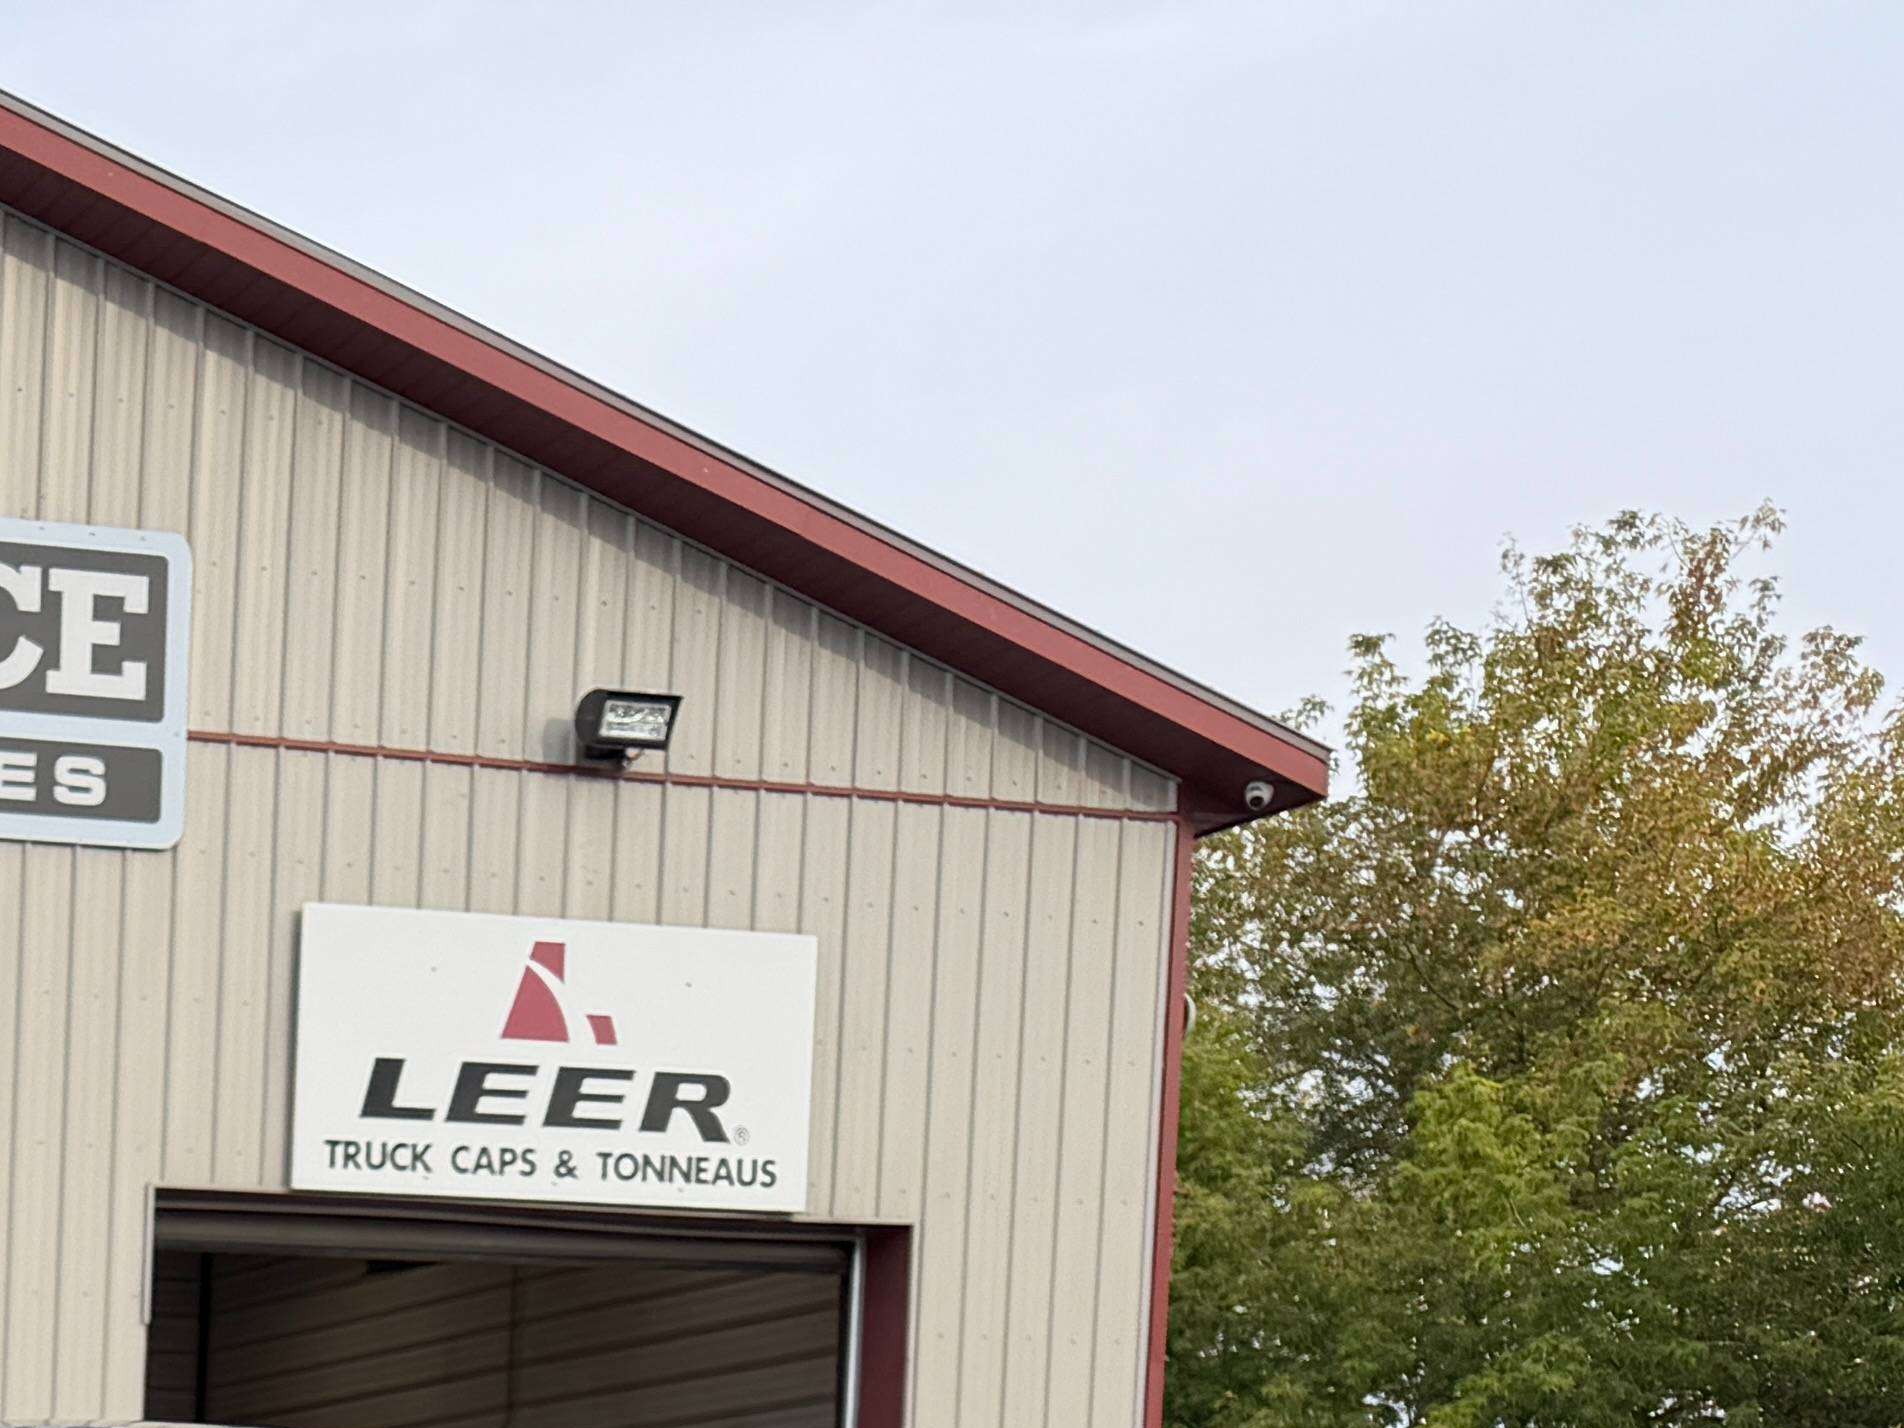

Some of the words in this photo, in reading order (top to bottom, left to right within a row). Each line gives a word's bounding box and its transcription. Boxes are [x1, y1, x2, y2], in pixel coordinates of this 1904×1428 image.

[359, 1056, 732, 1145] LEER
[324, 1139, 433, 1173] TRUCK
[451, 1144, 537, 1178] CAPS
[553, 1149, 579, 1180] &
[596, 1151, 778, 1189] TONNEAUS
